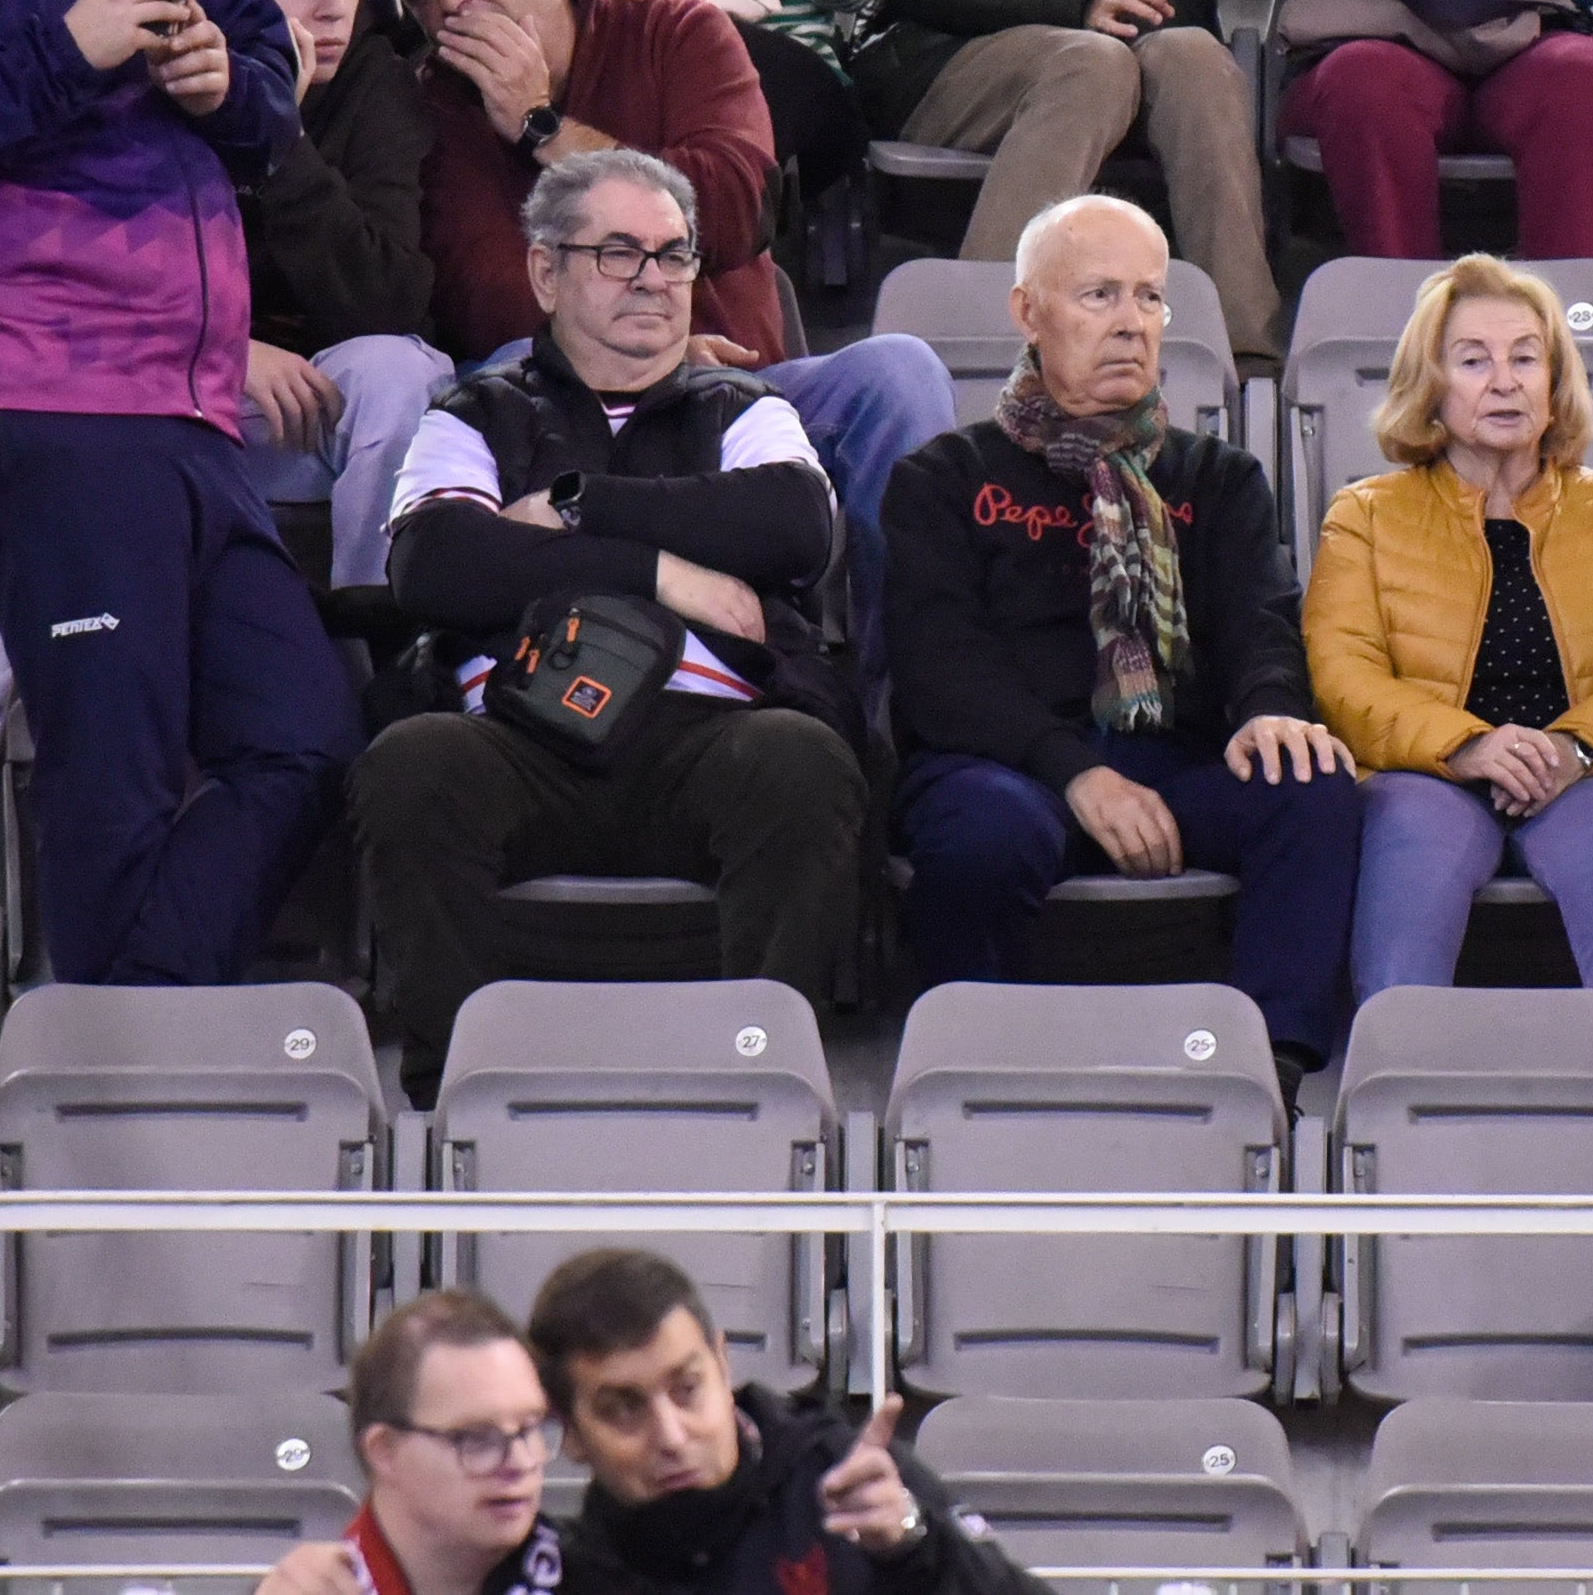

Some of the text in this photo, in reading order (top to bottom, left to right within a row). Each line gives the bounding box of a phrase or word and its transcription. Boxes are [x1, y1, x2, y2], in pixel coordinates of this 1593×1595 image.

[1572, 311, 1591, 323] 23
[973, 482, 1078, 541] Pepe
[290, 1038, 311, 1052] 29
[742, 1035, 760, 1049] 27
[1191, 1039, 1211, 1052] 25
[1210, 1453, 1229, 1467] 25
